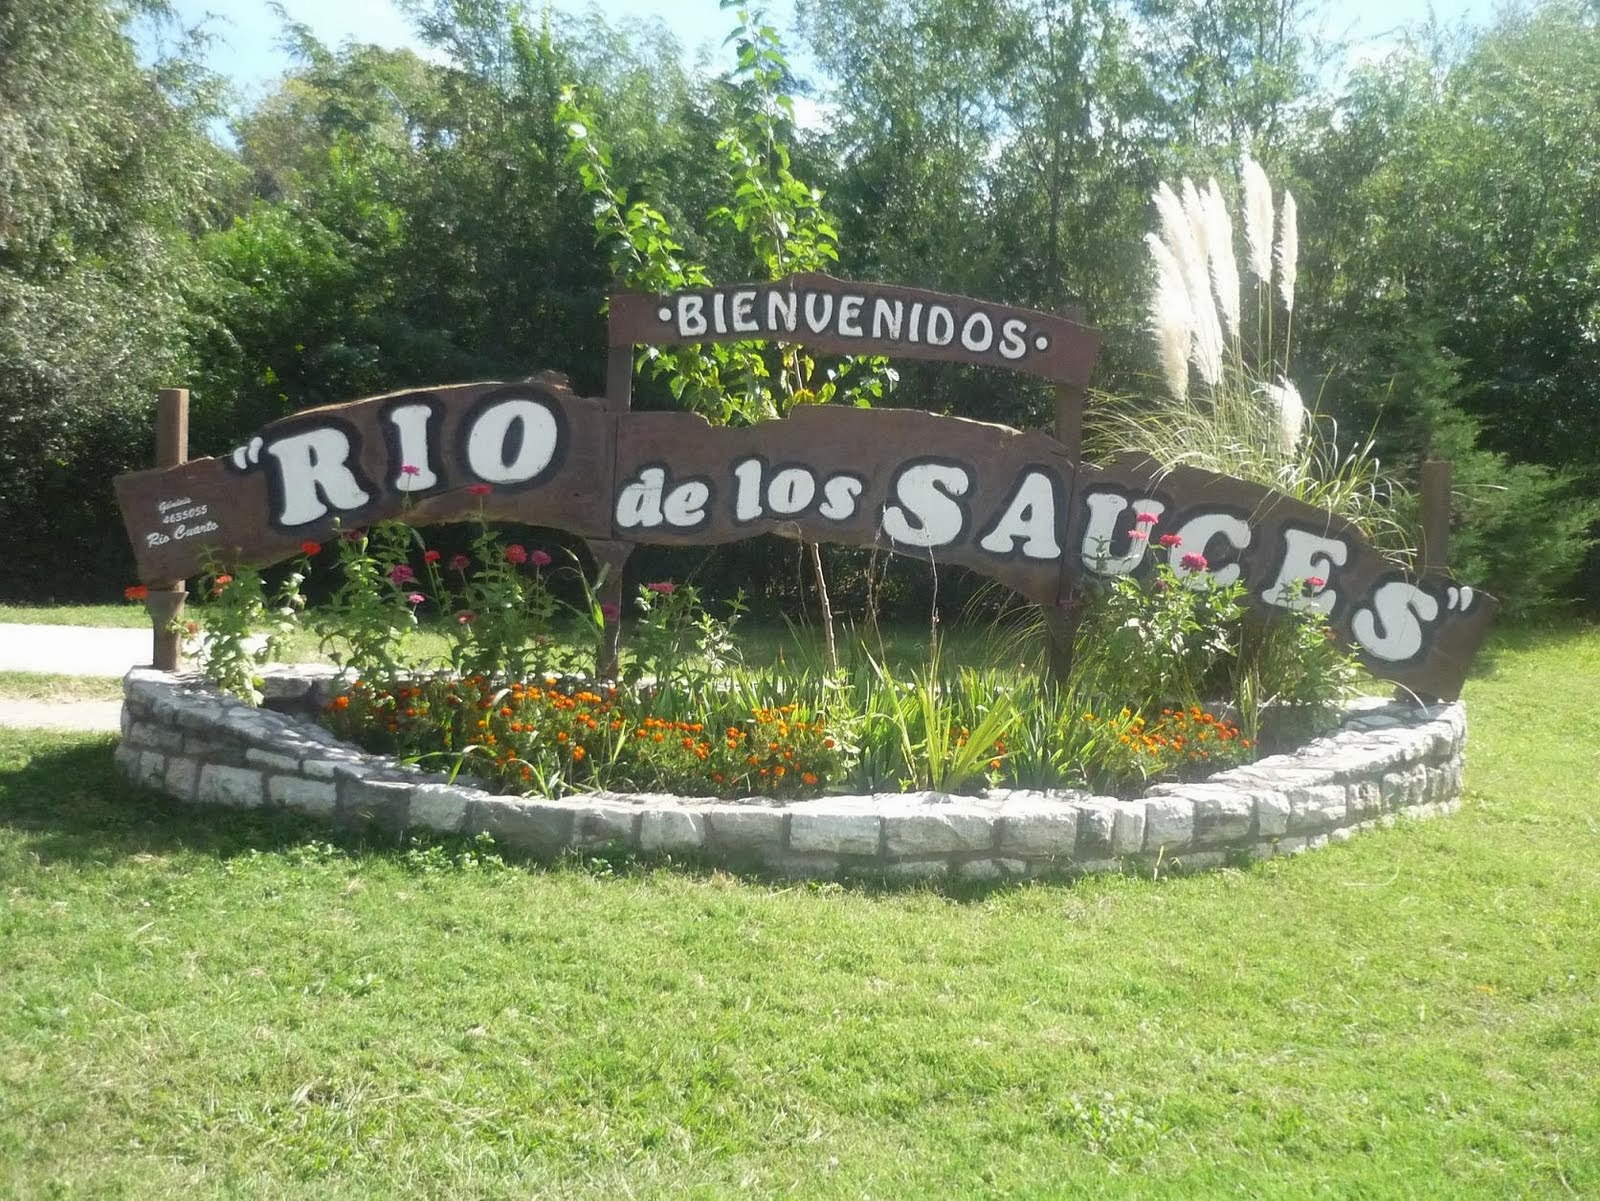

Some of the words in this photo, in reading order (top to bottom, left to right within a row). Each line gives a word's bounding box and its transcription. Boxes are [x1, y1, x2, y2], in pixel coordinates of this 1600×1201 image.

[616, 467, 709, 527] de
[735, 458, 863, 521] los
[146, 532, 171, 548] Rio
[174, 521, 219, 540] Cuarto
